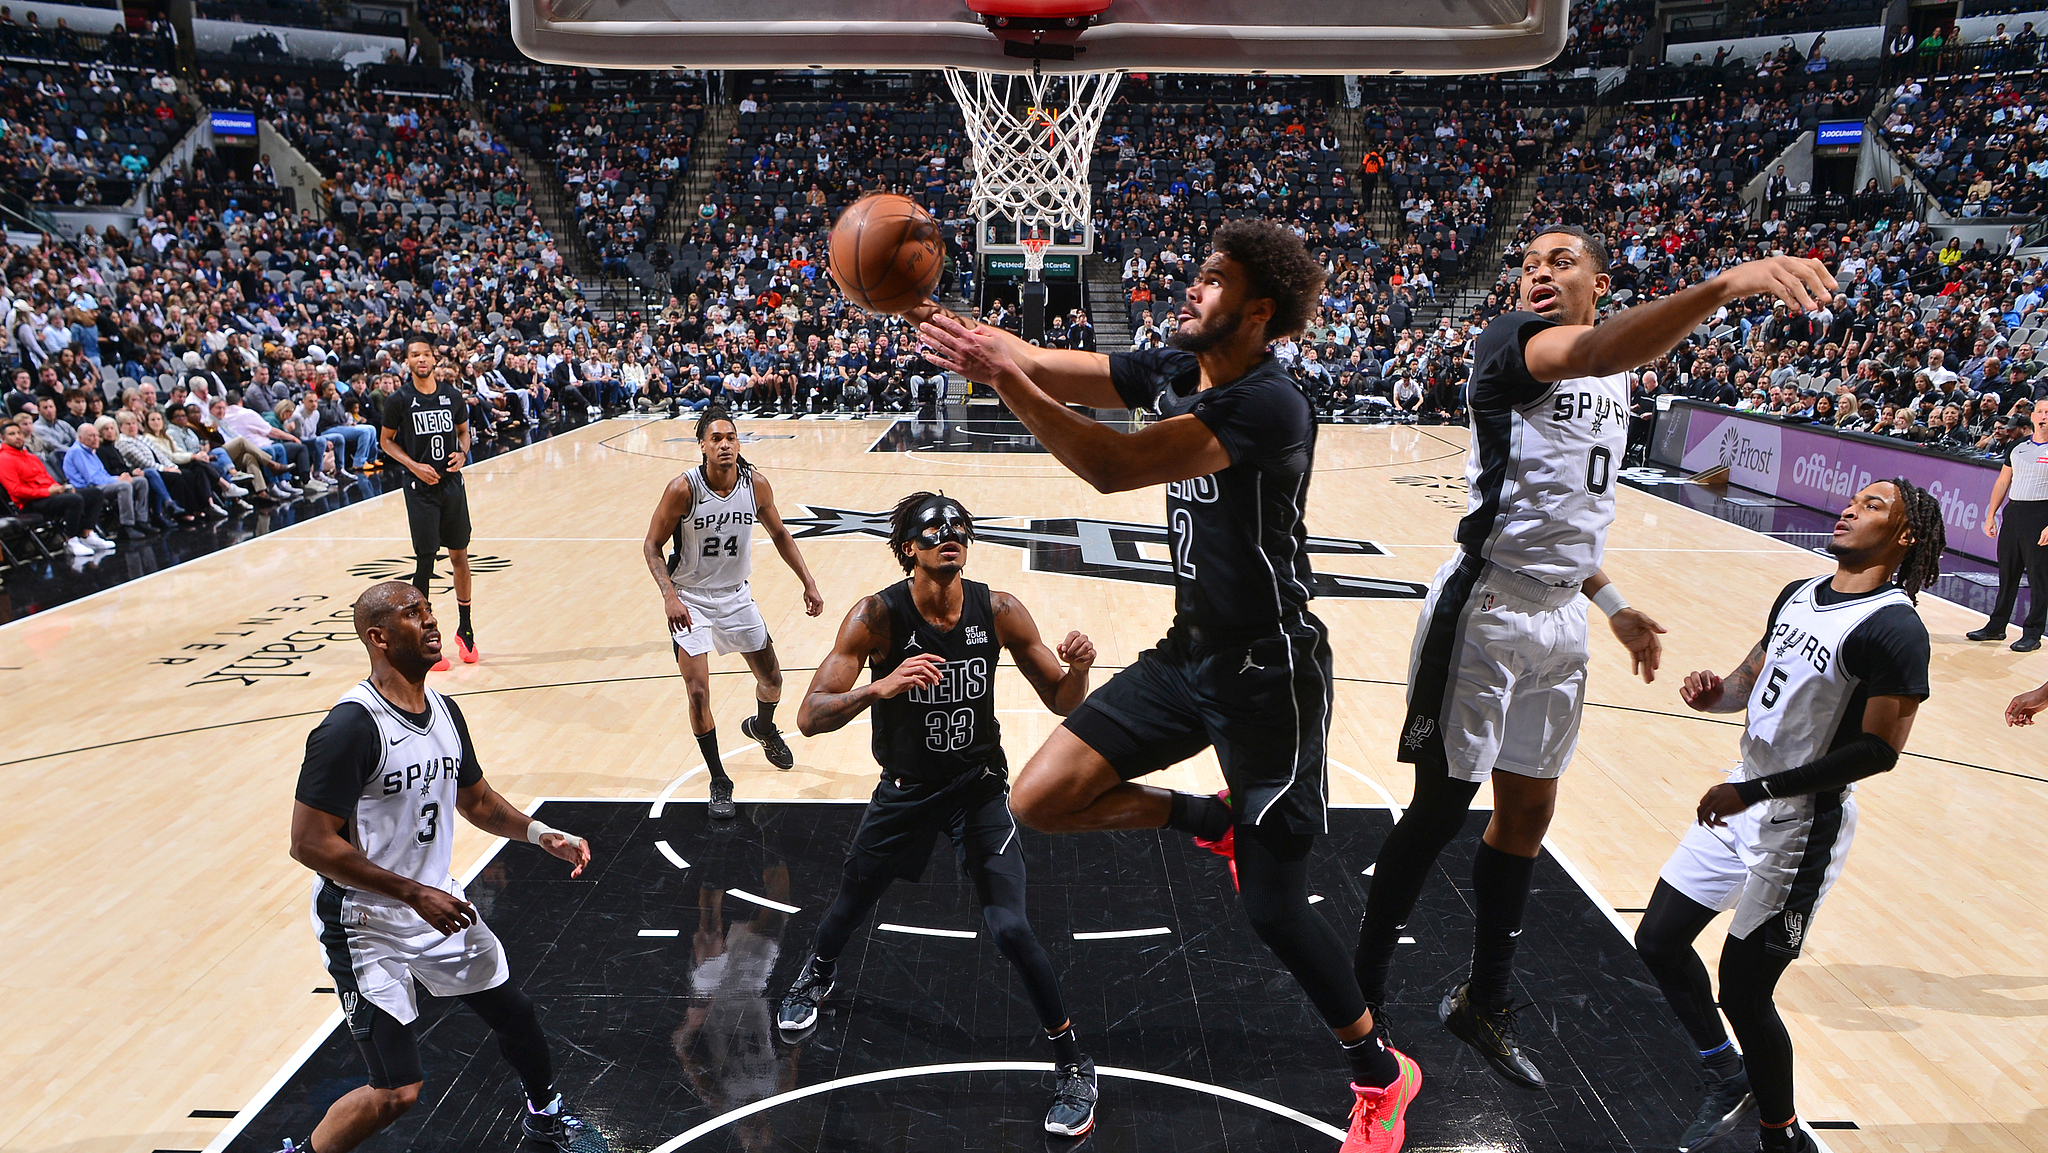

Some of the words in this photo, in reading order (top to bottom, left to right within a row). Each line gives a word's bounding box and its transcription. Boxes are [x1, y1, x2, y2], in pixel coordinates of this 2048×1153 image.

[412, 409, 454, 435] NETS
[1552, 391, 1630, 438] SPUR
[430, 434, 445, 462] 8
[1584, 443, 1611, 497] 0
[1737, 437, 1774, 475] Frost
[1792, 453, 1857, 498] Official
[1940, 487, 1979, 531] the
[694, 511, 753, 533] SPURS
[1173, 508, 1196, 580] 2
[702, 534, 739, 558] 24
[148, 593, 330, 666] CENTER
[964, 625, 979, 634] GET
[965, 630, 987, 640] YOUR
[966, 636, 989, 646] GUIDE
[1773, 623, 1831, 674] PURS
[1760, 664, 1791, 712] 5
[925, 707, 975, 753] 33
[382, 756, 461, 799] SPURS
[416, 801, 440, 848] 3
